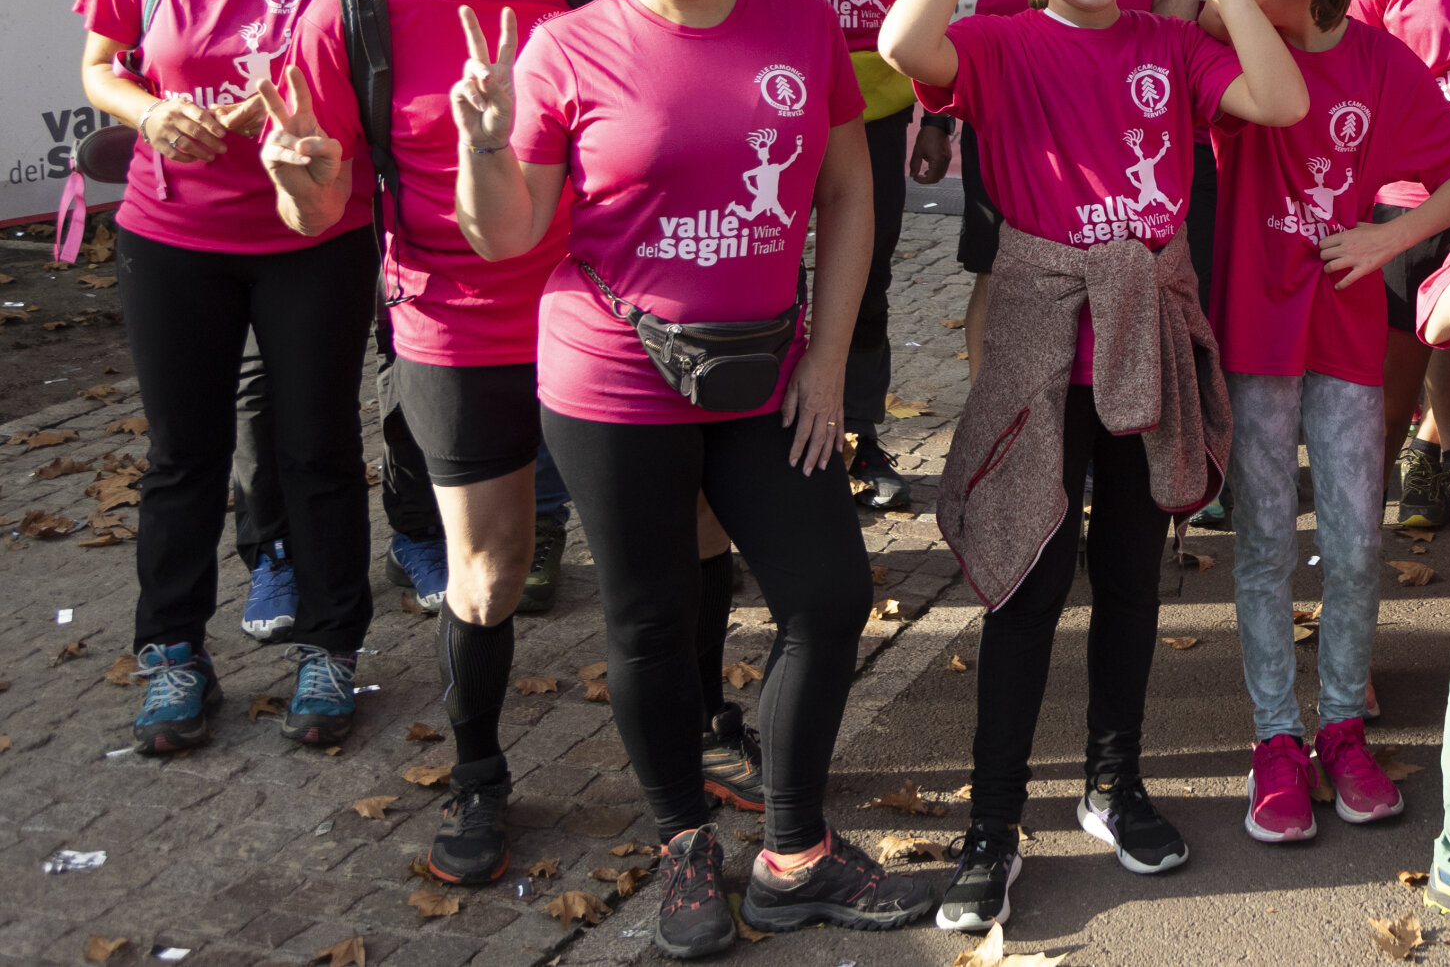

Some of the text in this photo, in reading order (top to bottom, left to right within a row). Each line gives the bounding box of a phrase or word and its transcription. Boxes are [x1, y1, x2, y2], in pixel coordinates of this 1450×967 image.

[754, 64, 806, 83] VALLE CAMONICA
[778, 109, 804, 117] SERVIZI
[1329, 101, 1347, 115] VALLE
[659, 209, 739, 238] valle
[753, 226, 782, 239] Wine
[752, 239, 786, 255] Trail.it
